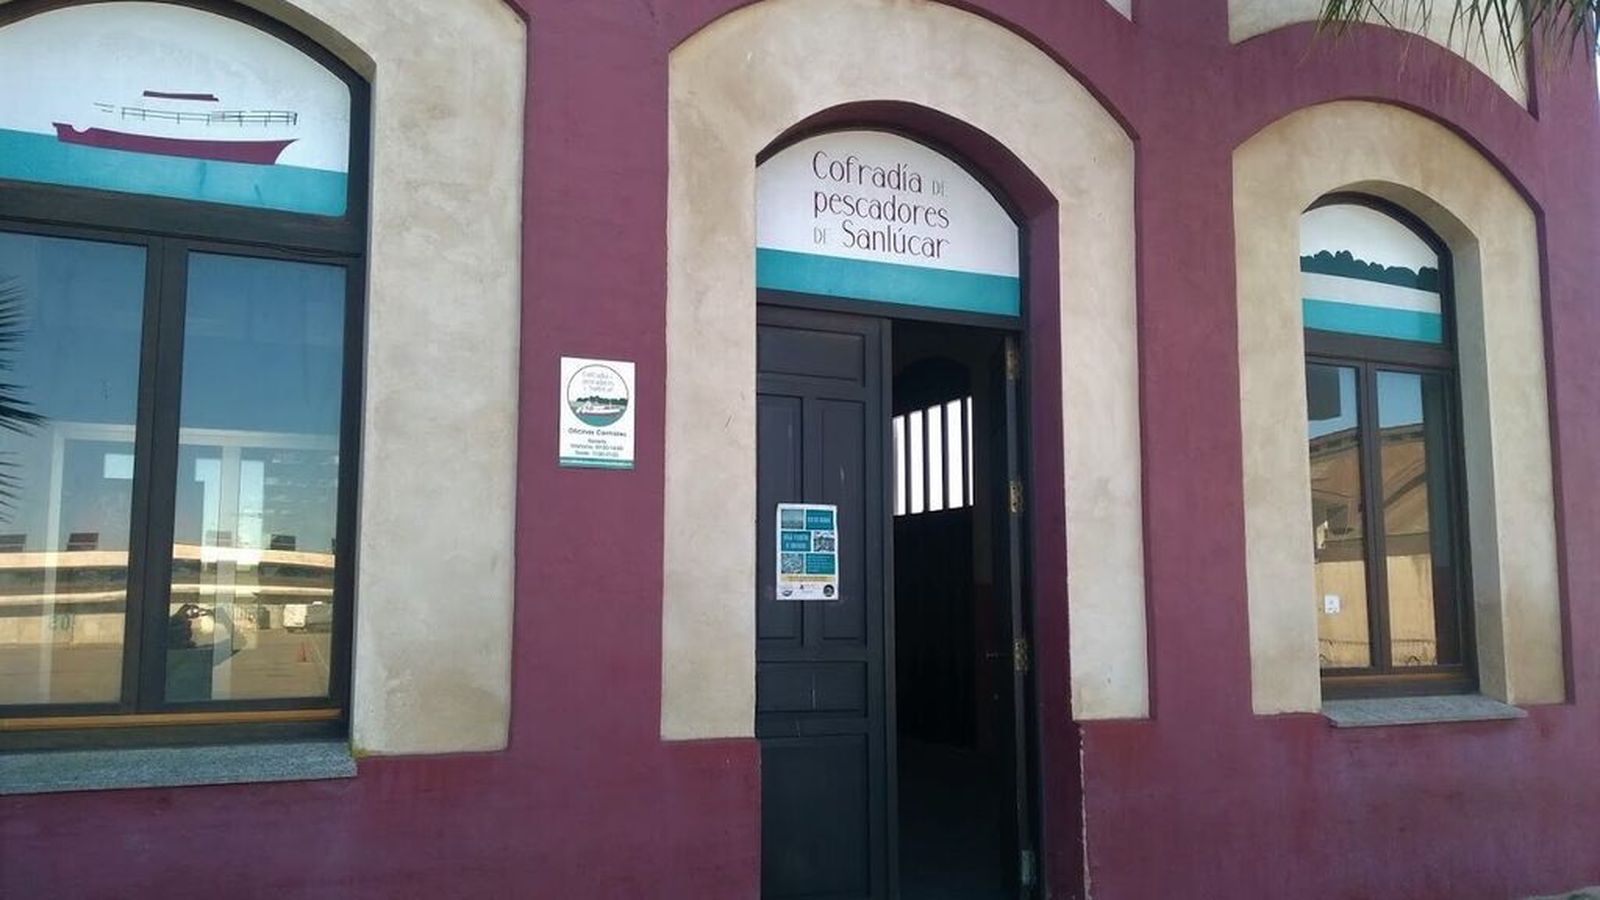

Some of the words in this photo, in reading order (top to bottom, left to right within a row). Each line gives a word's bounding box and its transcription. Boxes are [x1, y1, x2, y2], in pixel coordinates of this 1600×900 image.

[813, 150, 922, 193] Cofradía
[813, 190, 950, 229] pescadores
[841, 219, 950, 259] Sanlúcar
